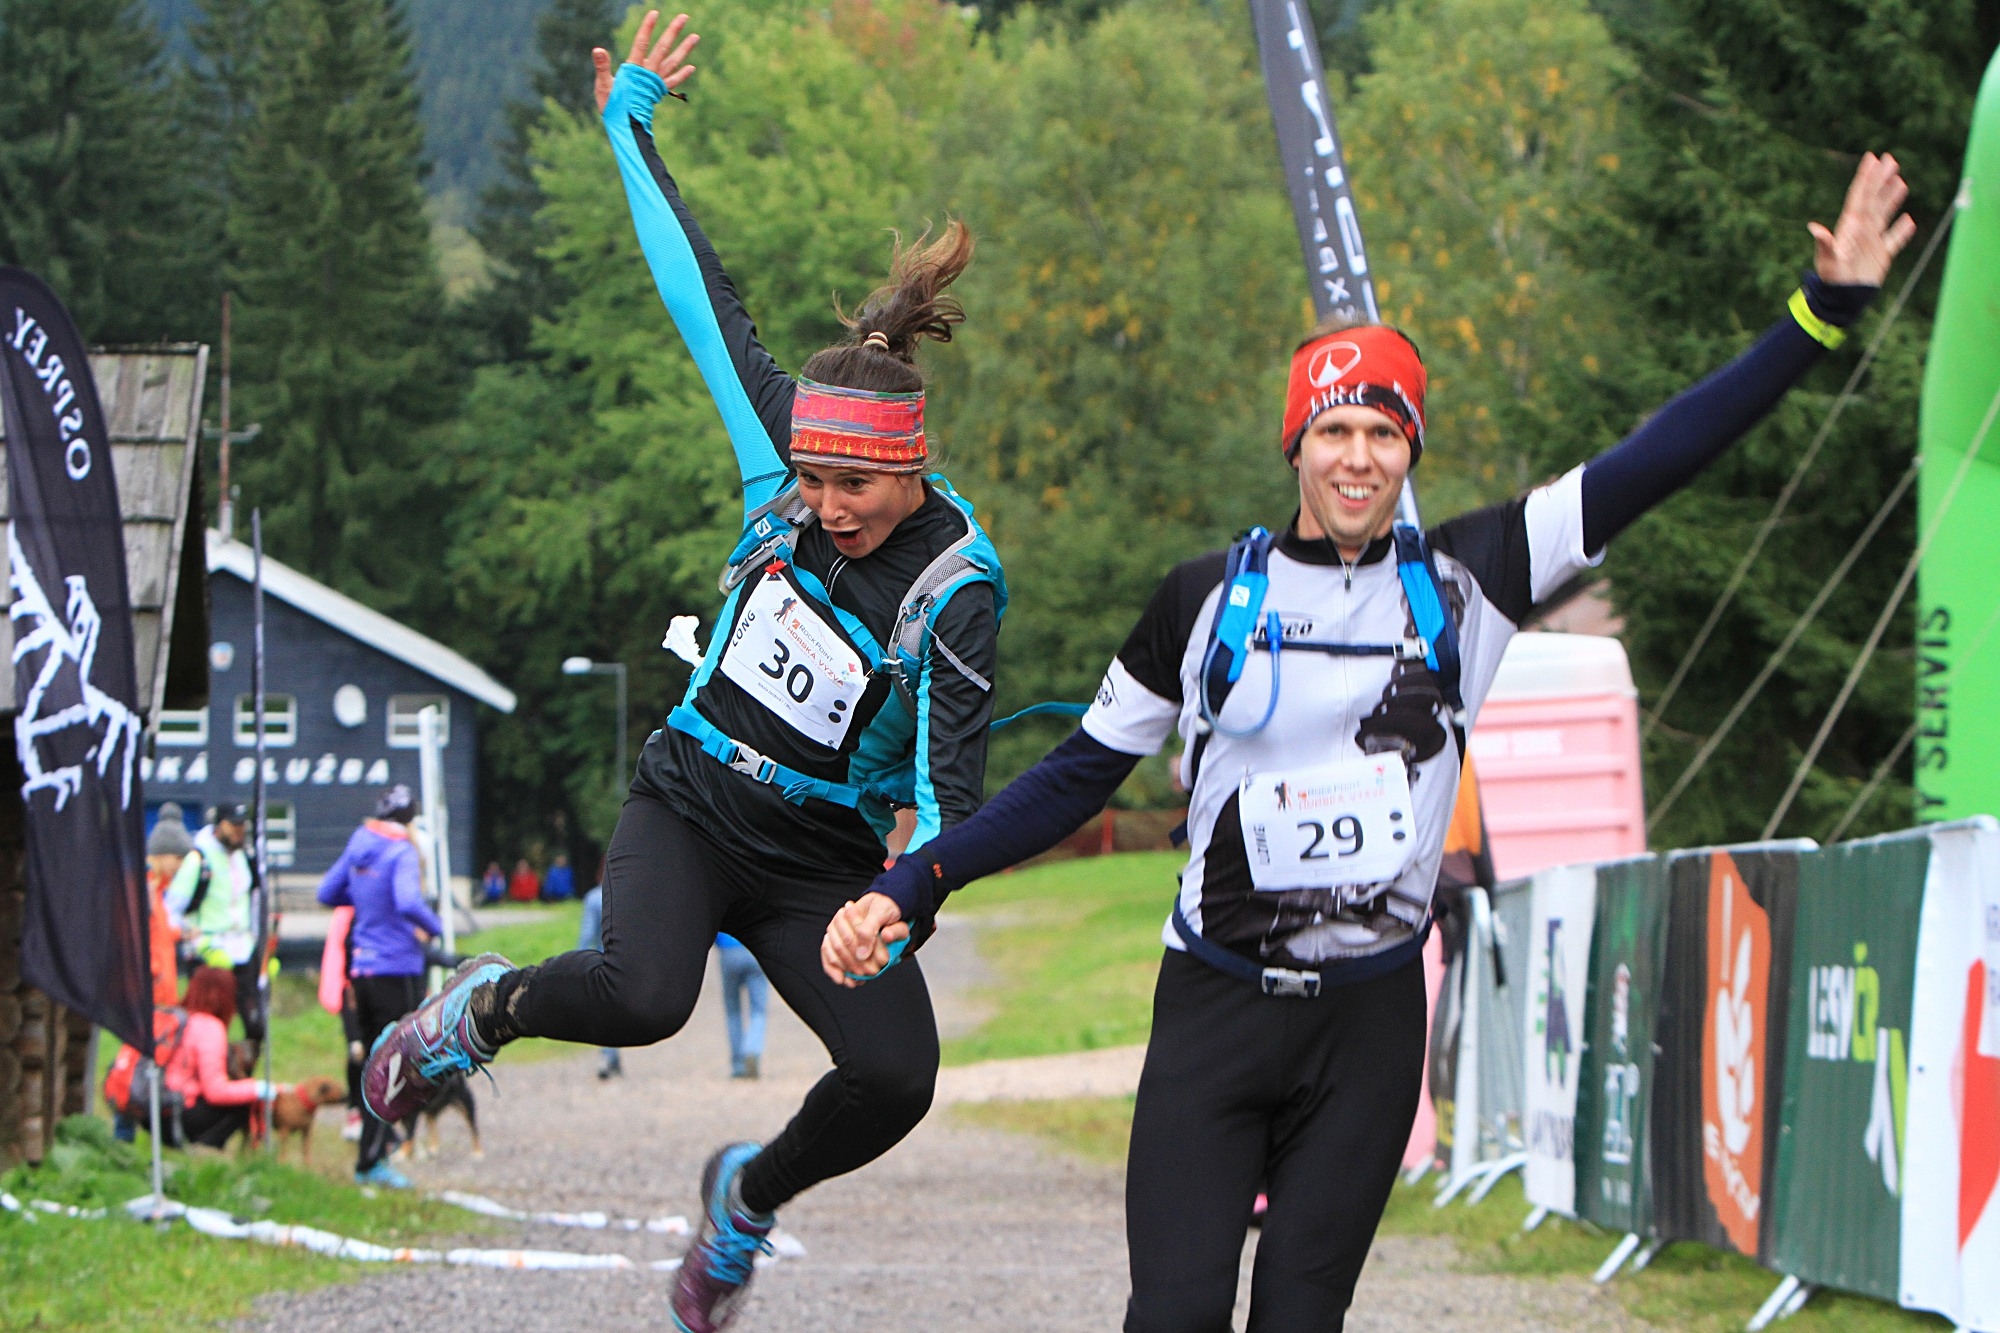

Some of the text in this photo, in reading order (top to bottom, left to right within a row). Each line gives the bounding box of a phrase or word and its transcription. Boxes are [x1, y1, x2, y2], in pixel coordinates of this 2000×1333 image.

[732, 609, 756, 648] LONG
[758, 638, 814, 703] 30
[1921, 606, 1951, 770] SERVIS
[1297, 815, 1364, 860] 29
